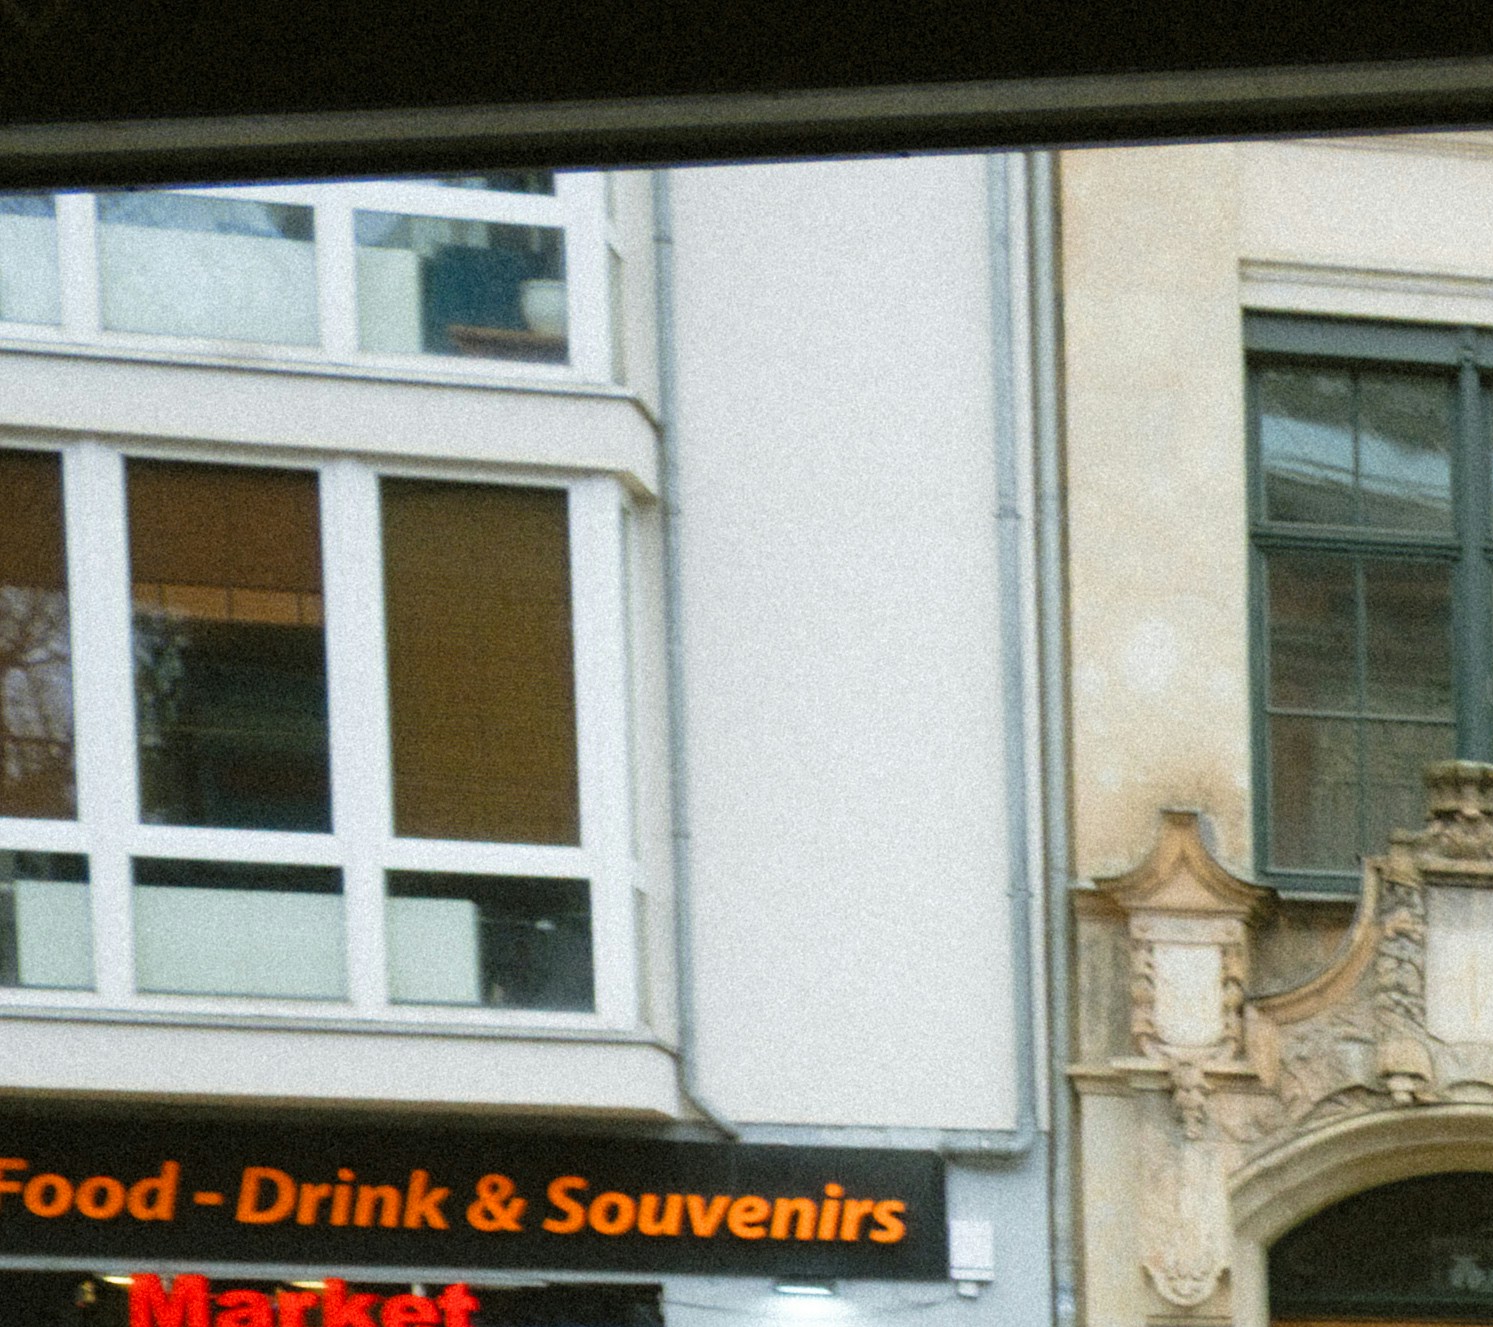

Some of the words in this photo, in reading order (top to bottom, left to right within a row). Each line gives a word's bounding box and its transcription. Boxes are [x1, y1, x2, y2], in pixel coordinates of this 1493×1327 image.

[235, 1166, 450, 1231] Drink
[466, 1173, 528, 1233] &
[541, 1175, 906, 1244] Souvenirs
